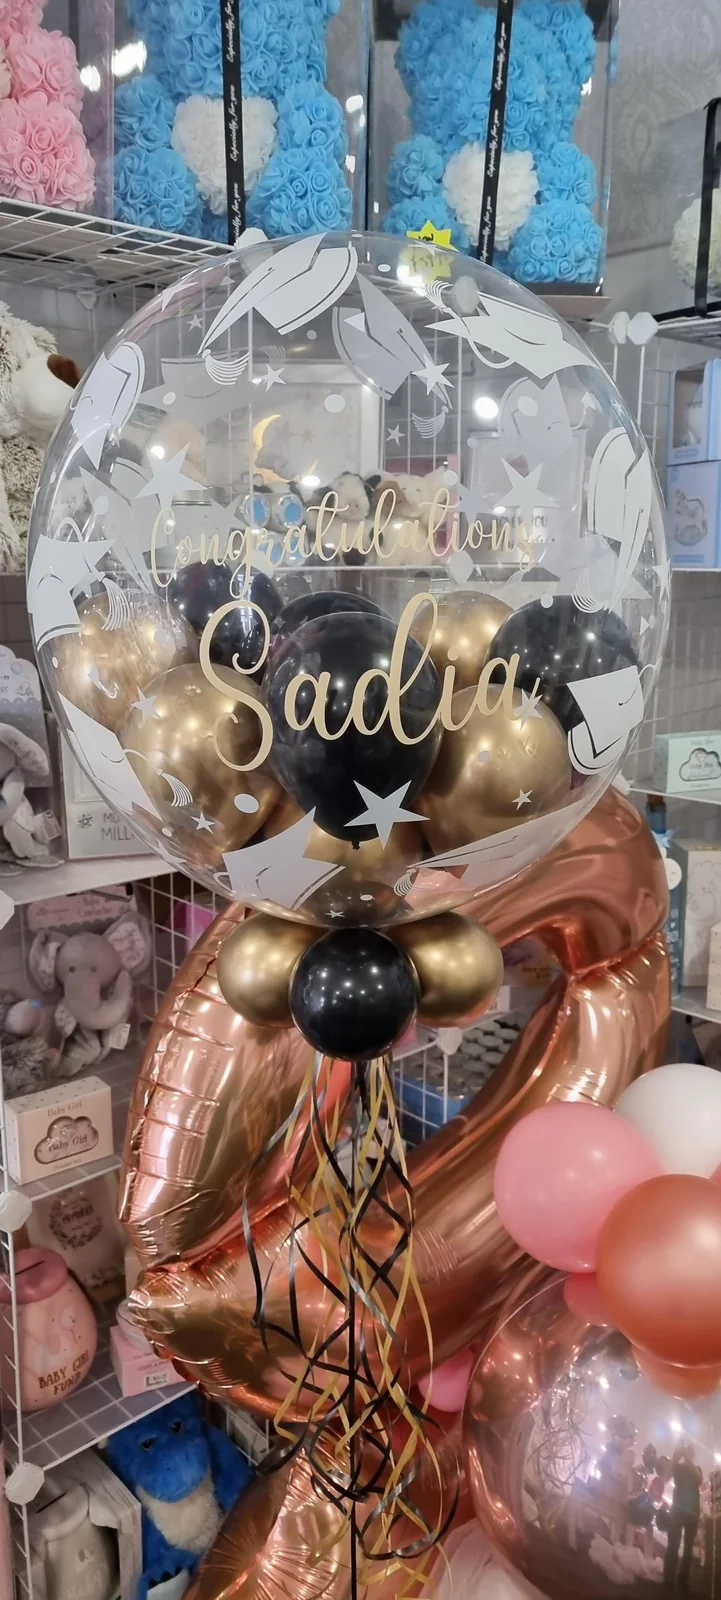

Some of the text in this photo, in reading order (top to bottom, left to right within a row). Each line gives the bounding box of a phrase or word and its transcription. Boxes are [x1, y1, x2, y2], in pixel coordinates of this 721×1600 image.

[150, 488, 537, 599] Congratulations
[199, 592, 541, 772] Sadia
[38, 1366, 67, 1389] BABY
